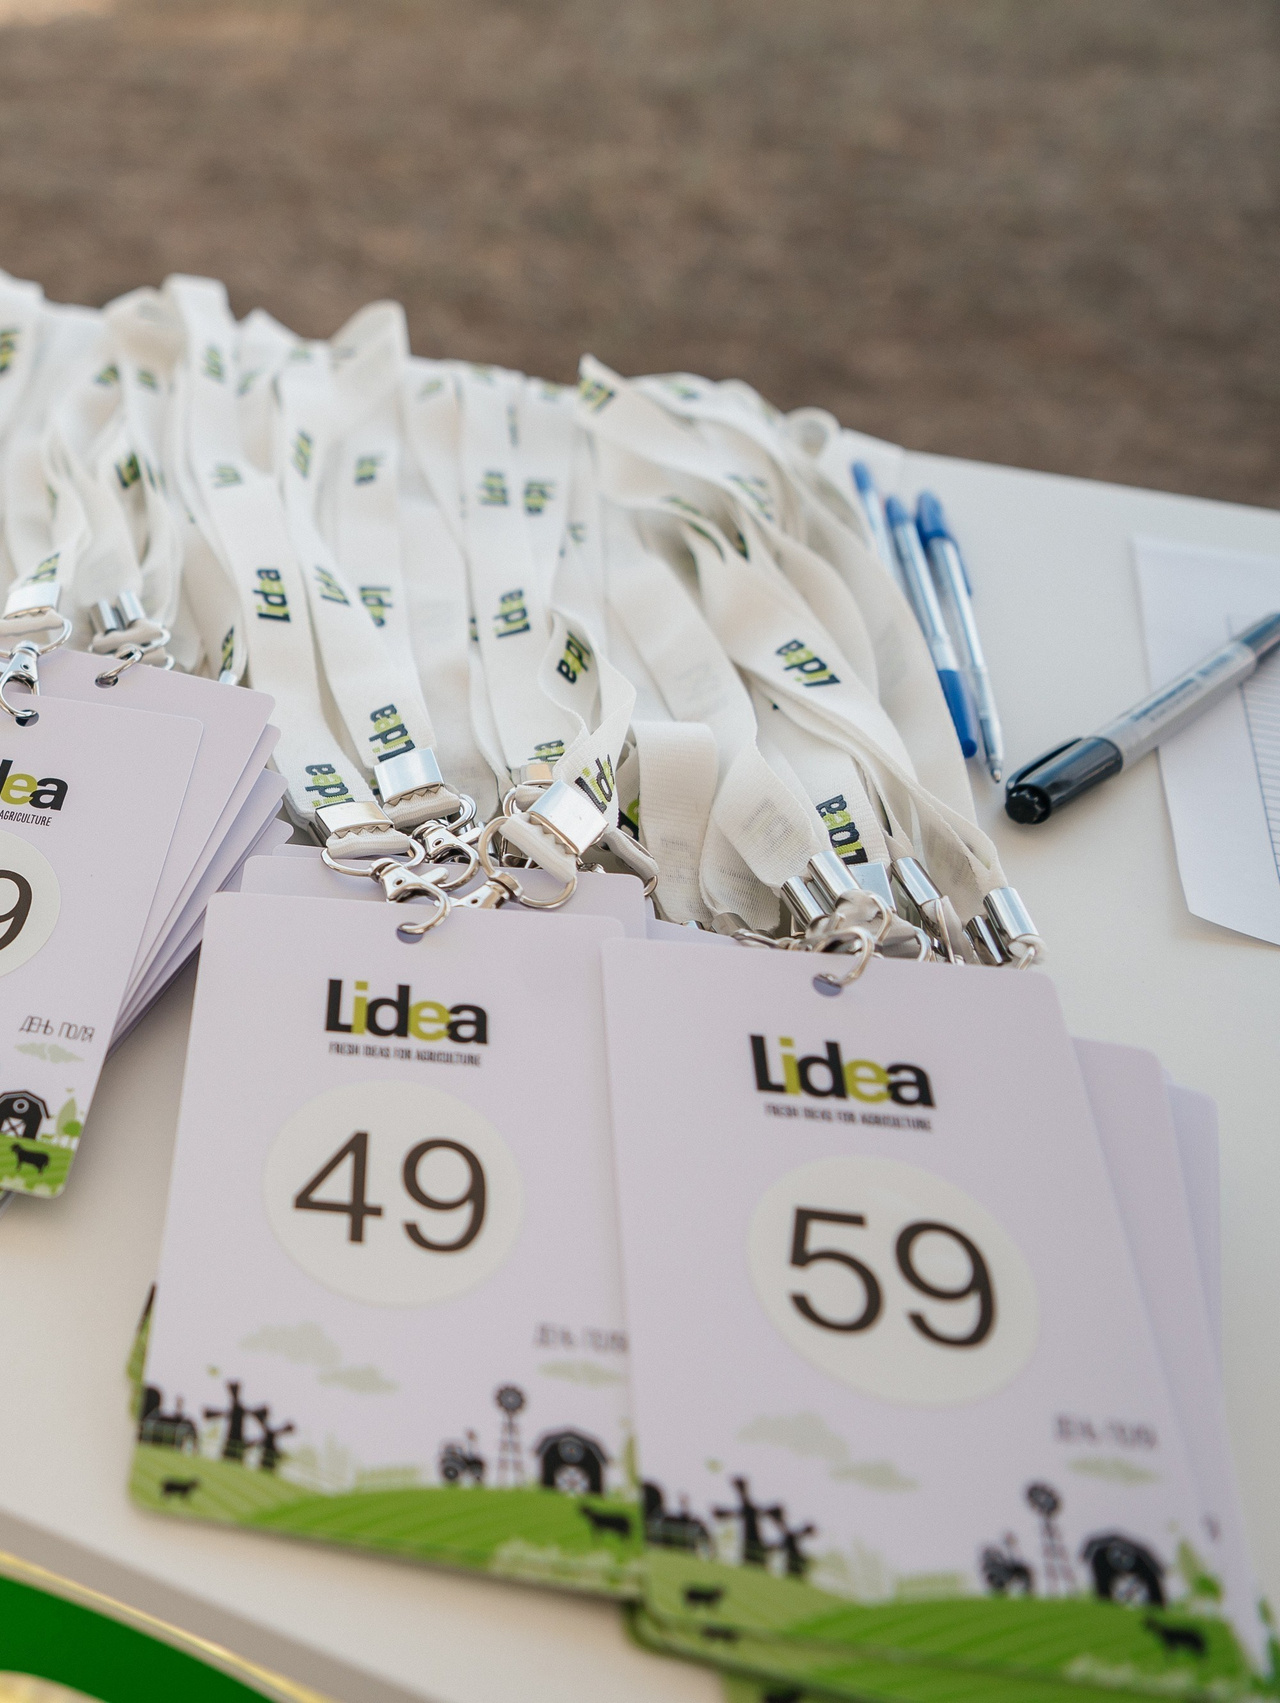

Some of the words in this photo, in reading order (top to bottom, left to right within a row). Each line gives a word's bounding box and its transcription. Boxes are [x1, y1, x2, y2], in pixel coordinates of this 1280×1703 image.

[775, 638, 842, 687] Lidea
[368, 703, 416, 762] Lidea
[325, 978, 489, 1045] Lidea
[329, 1041, 359, 1056] FRESH
[362, 1044, 390, 1058] IDEAS
[393, 1047, 411, 1061] FOR
[415, 1049, 481, 1067] AGRICULTURE
[749, 1033, 937, 1109] Lidea
[293, 1131, 488, 1254] 49
[788, 1206, 998, 1349] 59
